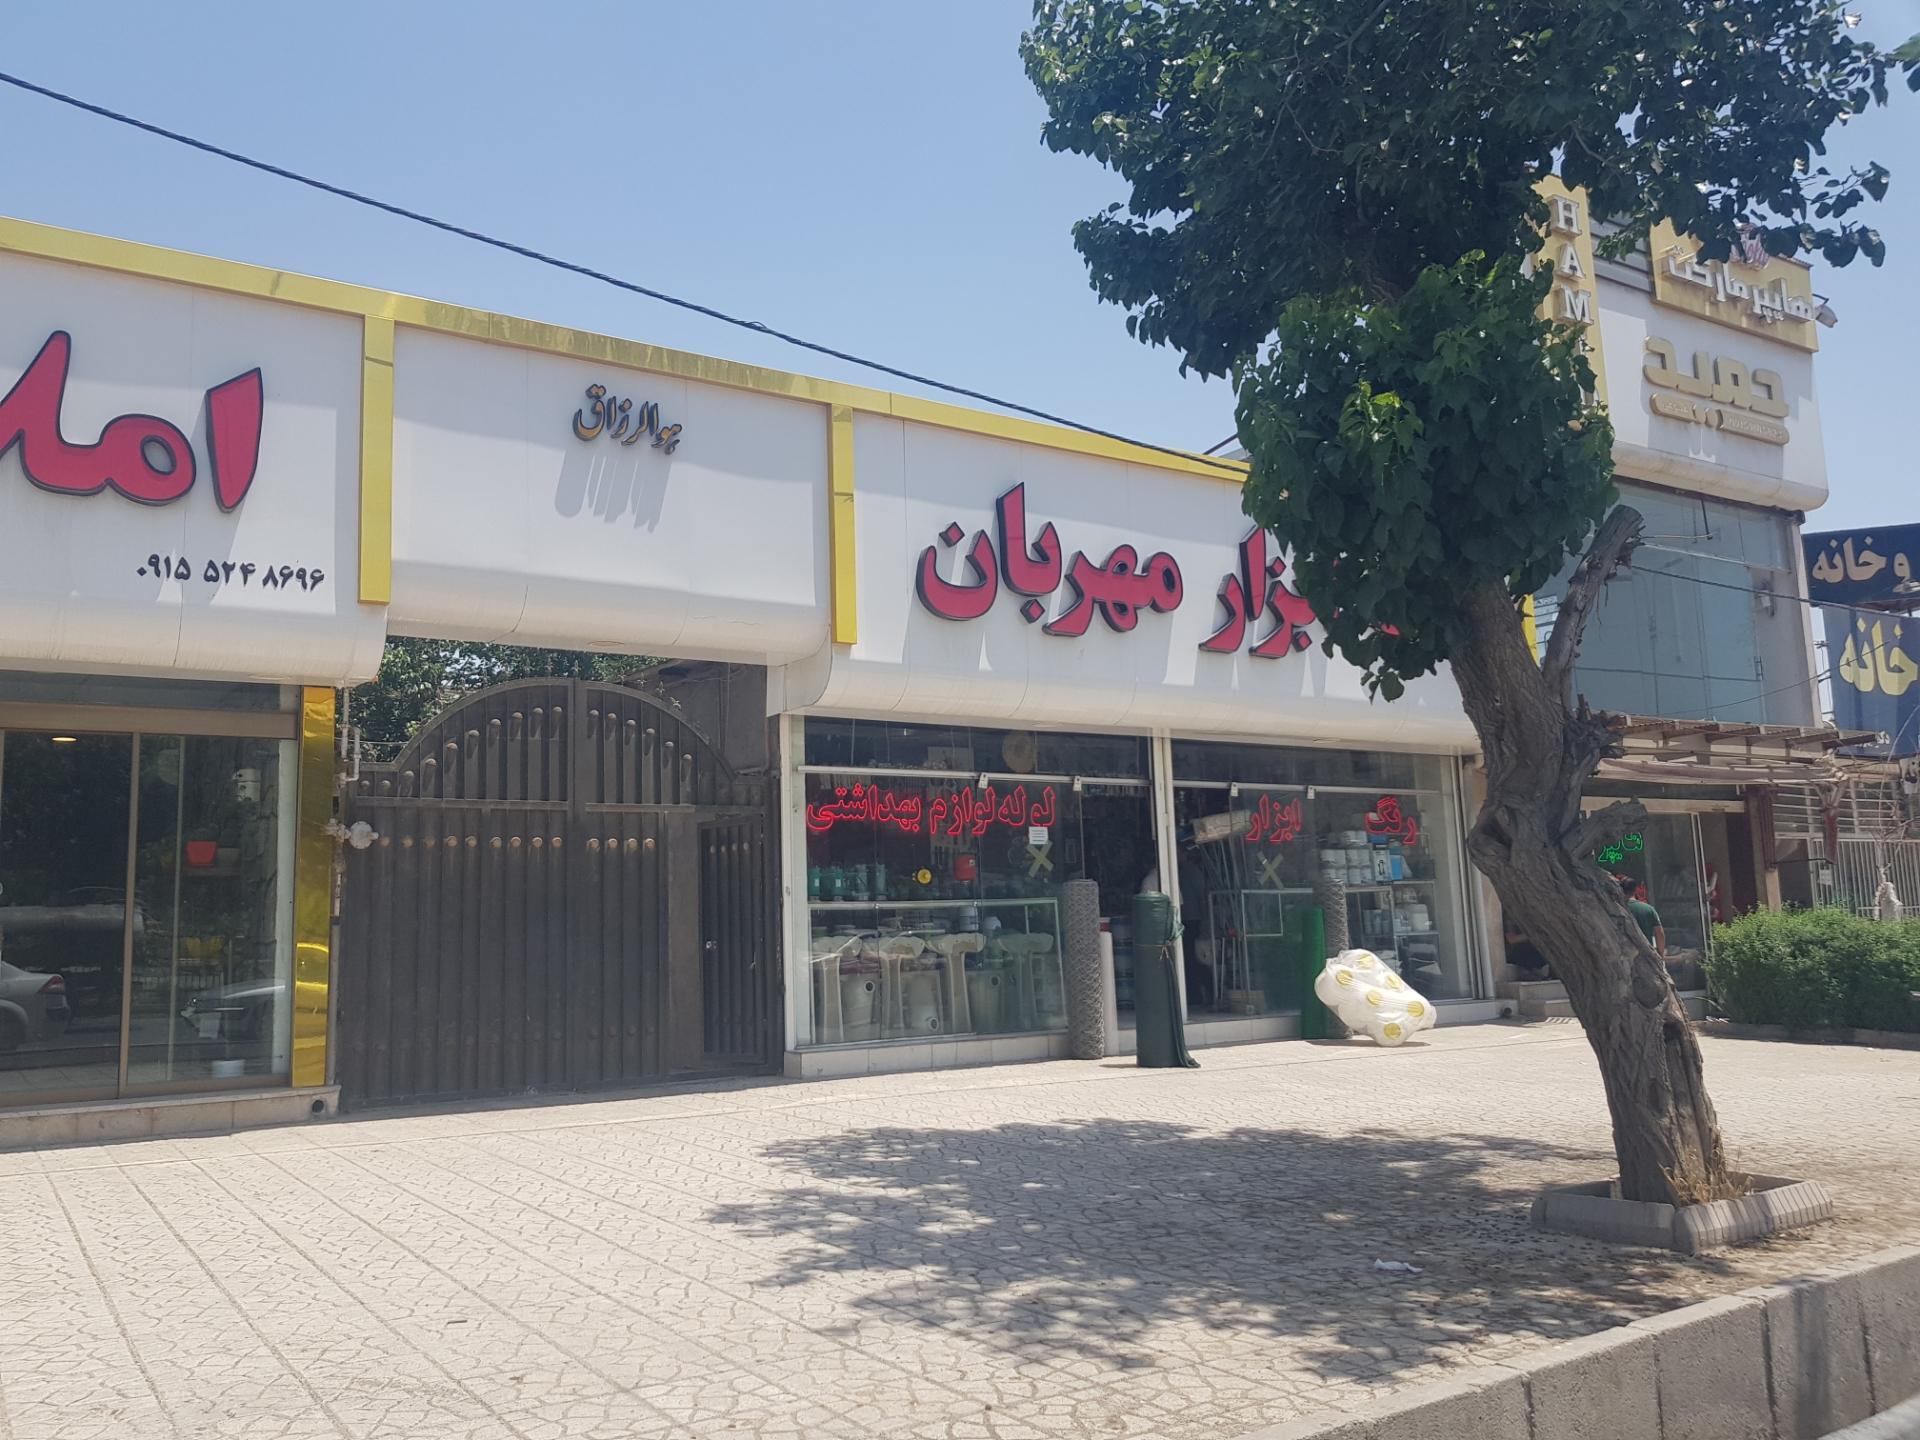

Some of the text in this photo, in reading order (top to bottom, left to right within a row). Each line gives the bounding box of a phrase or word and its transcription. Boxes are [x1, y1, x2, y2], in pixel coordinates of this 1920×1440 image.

[1643, 336, 1789, 418] حمید
[136, 553, 325, 591] ۰۹۱۵ ۵۲۴ ۸۶۹۶
[916, 482, 1322, 660] بزار مهربان
[1812, 536, 1887, 583] خانه
[1840, 616, 1919, 696] خانه
[806, 782, 921, 831] بهداشتی
[929, 786, 996, 835] لوازم
[1246, 792, 1302, 842] ابزار
